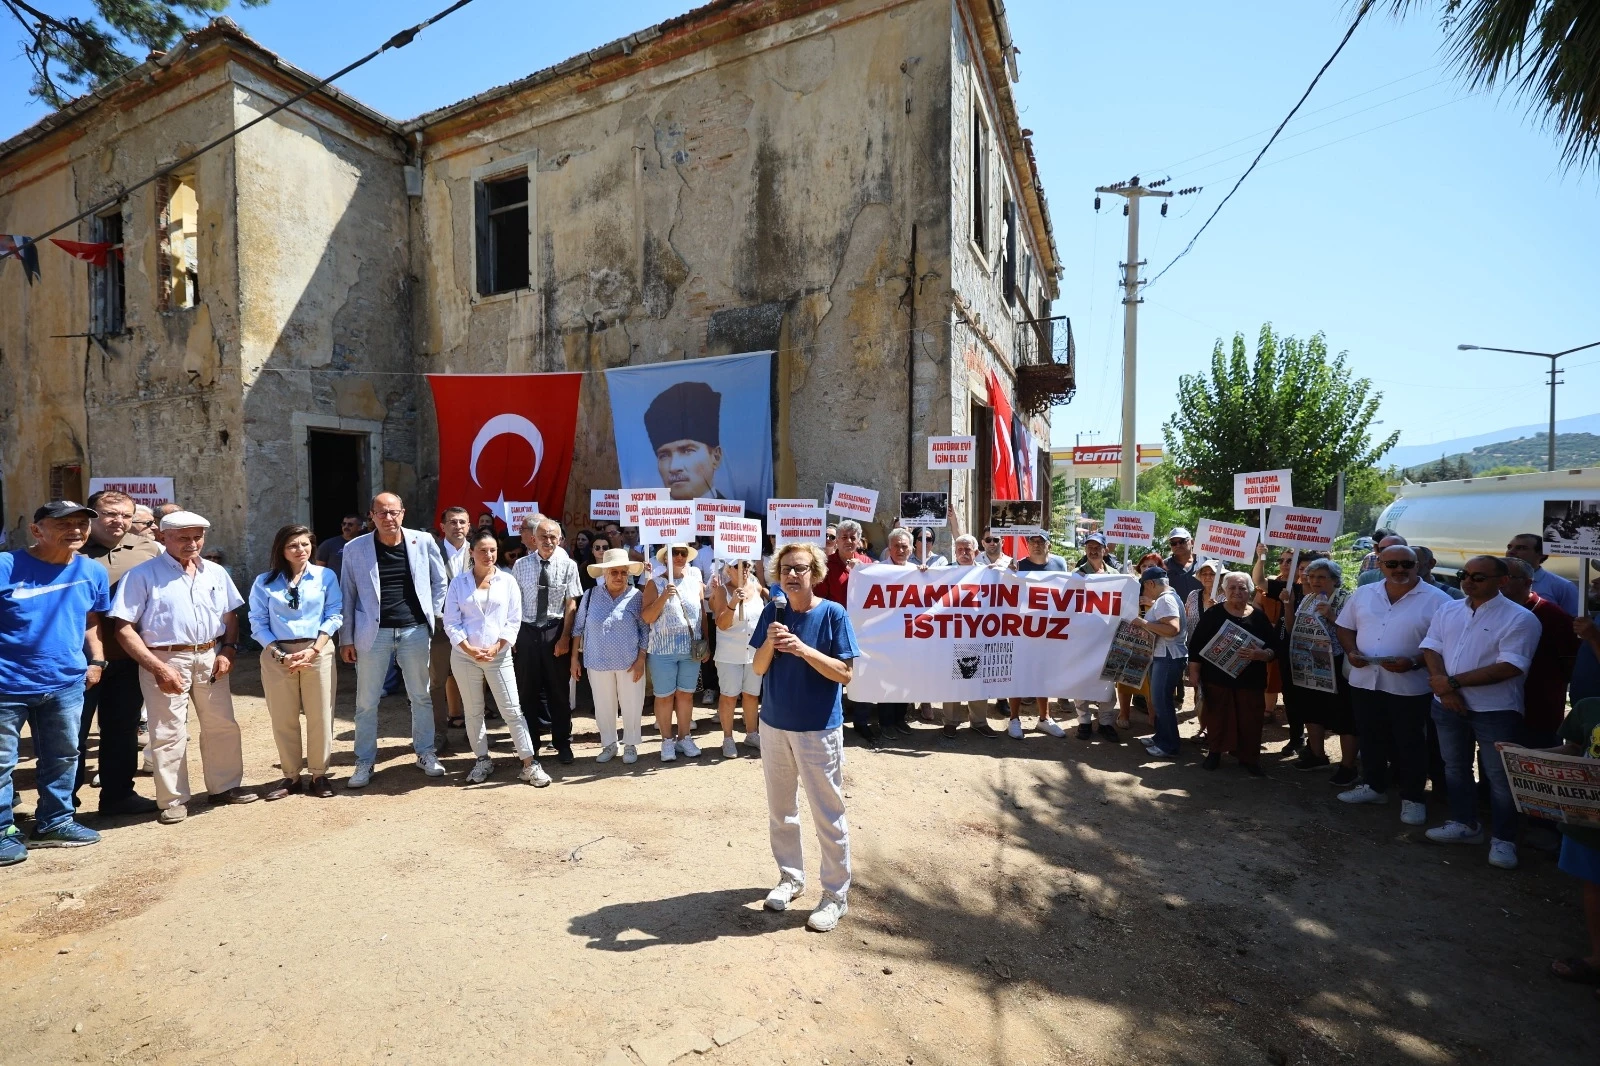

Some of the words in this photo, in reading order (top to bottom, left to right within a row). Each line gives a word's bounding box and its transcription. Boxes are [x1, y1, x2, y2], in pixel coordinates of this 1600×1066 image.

[932, 441, 960, 452] ATATÜRK
[960, 440, 972, 451] EVİ
[935, 454, 948, 464] İÇİN
[950, 454, 956, 463] EL
[957, 454, 968, 463] ELE
[1244, 486, 1260, 494] DEĞİL
[1248, 496, 1277, 504] İSTİYORUZ
[625, 504, 638, 513] BUG
[704, 514, 716, 523] TAŞI
[780, 516, 802, 526] ATATÜRK
[1286, 514, 1312, 524] ATATÜRK
[1312, 516, 1322, 524] EVİ
[1208, 524, 1222, 534] EFES
[863, 584, 1020, 609] ATAMIZ'IN
[1028, 586, 1122, 616] EVİNİ
[904, 613, 1070, 640] İSTİYORUZ
[1534, 763, 1586, 780] NEFES
